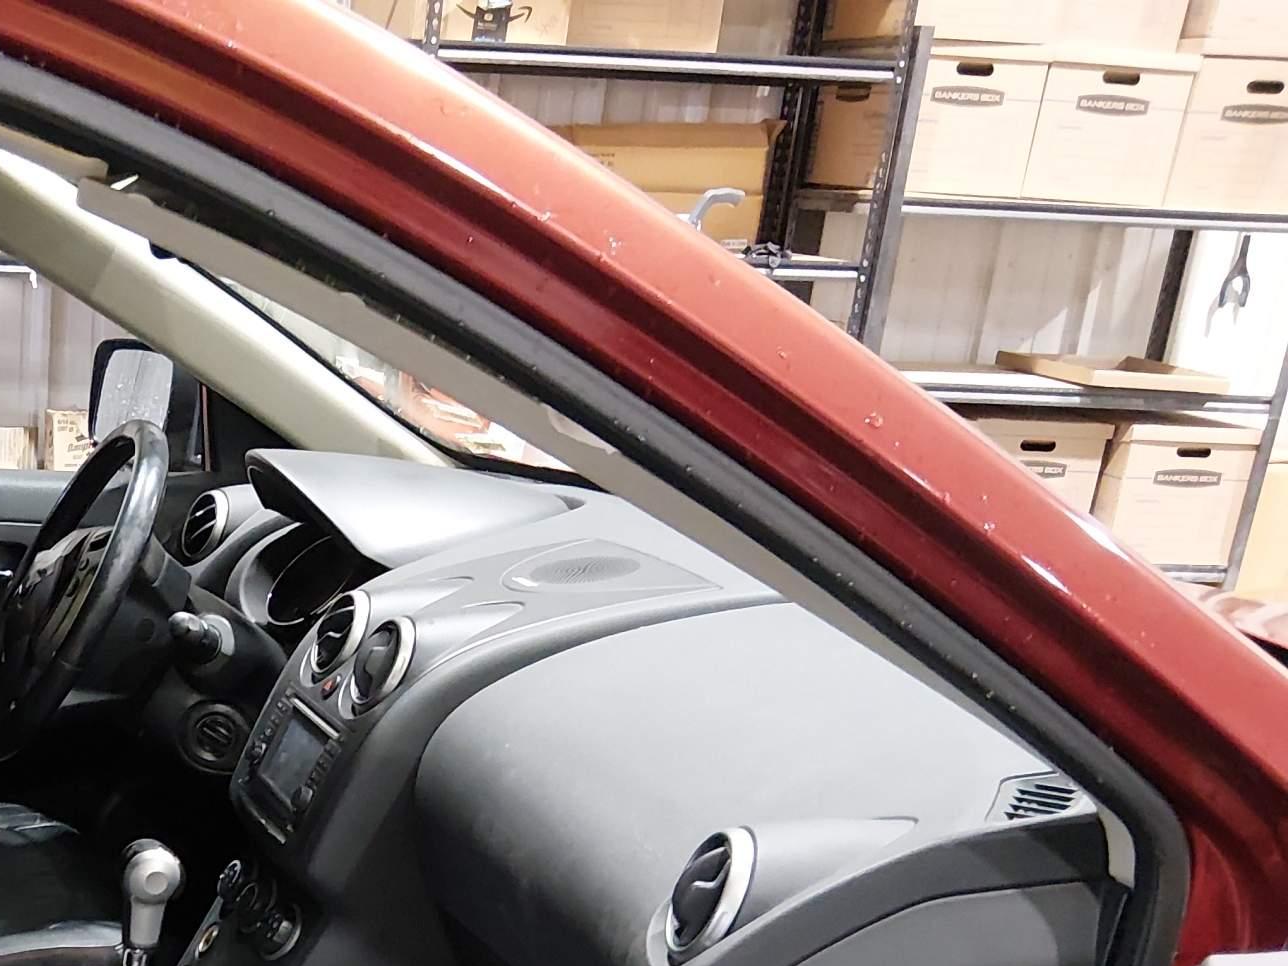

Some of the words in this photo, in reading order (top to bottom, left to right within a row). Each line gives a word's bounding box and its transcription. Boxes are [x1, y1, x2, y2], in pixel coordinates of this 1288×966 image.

[934, 90, 980, 102] BANKERS
[980, 93, 1001, 103] BOX
[1079, 98, 1125, 111] BANKERS
[1125, 102, 1145, 112] BOX
